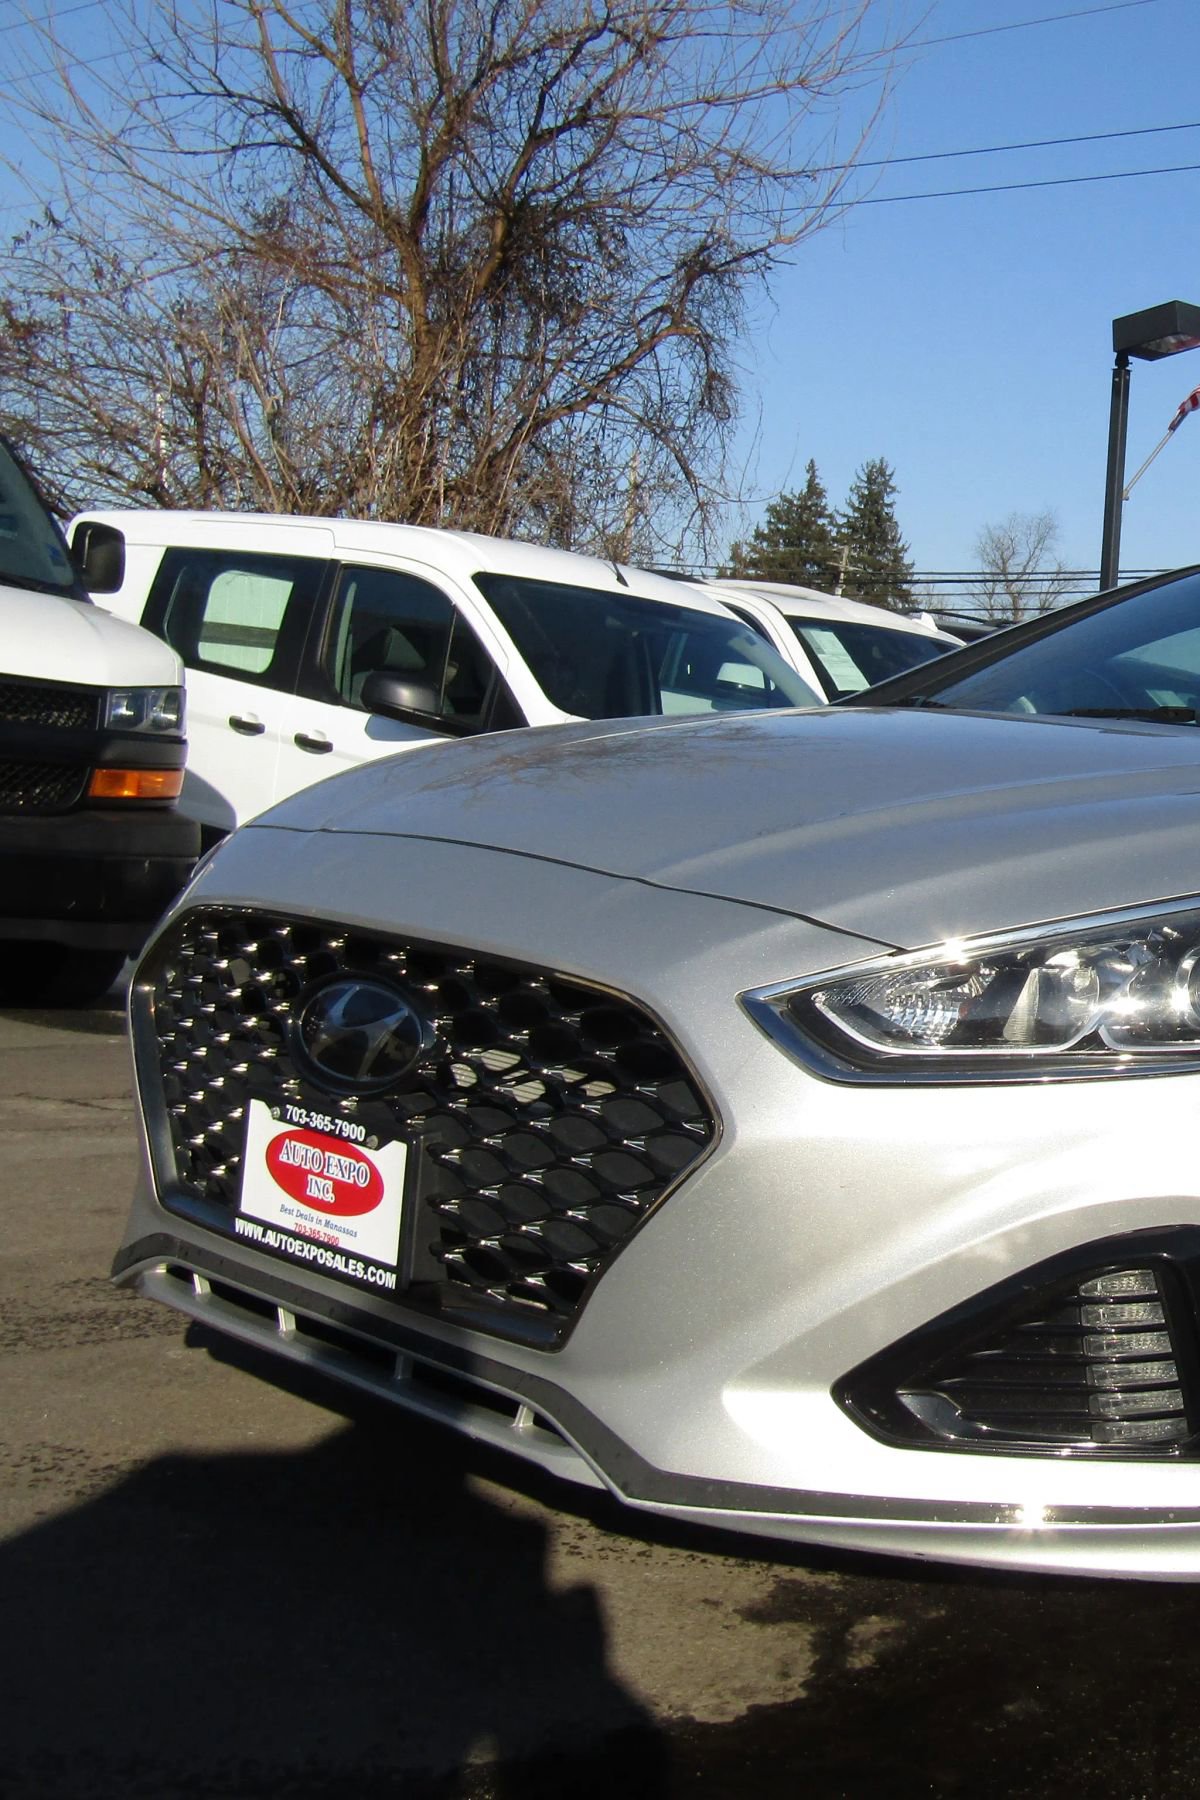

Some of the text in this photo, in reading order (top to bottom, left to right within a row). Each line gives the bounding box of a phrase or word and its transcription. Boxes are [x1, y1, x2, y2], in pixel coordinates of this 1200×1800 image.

[285, 1104, 366, 1142] 703-365-7900
[280, 1140, 370, 1187] AUTO EXPO
[307, 1176, 335, 1202] INC.
[279, 1203, 358, 1238] Best Deals in Manassas
[293, 1222, 340, 1246] 703-365-7900
[235, 1217, 397, 1290] WWW.AUTOEXPOSALES.COM
